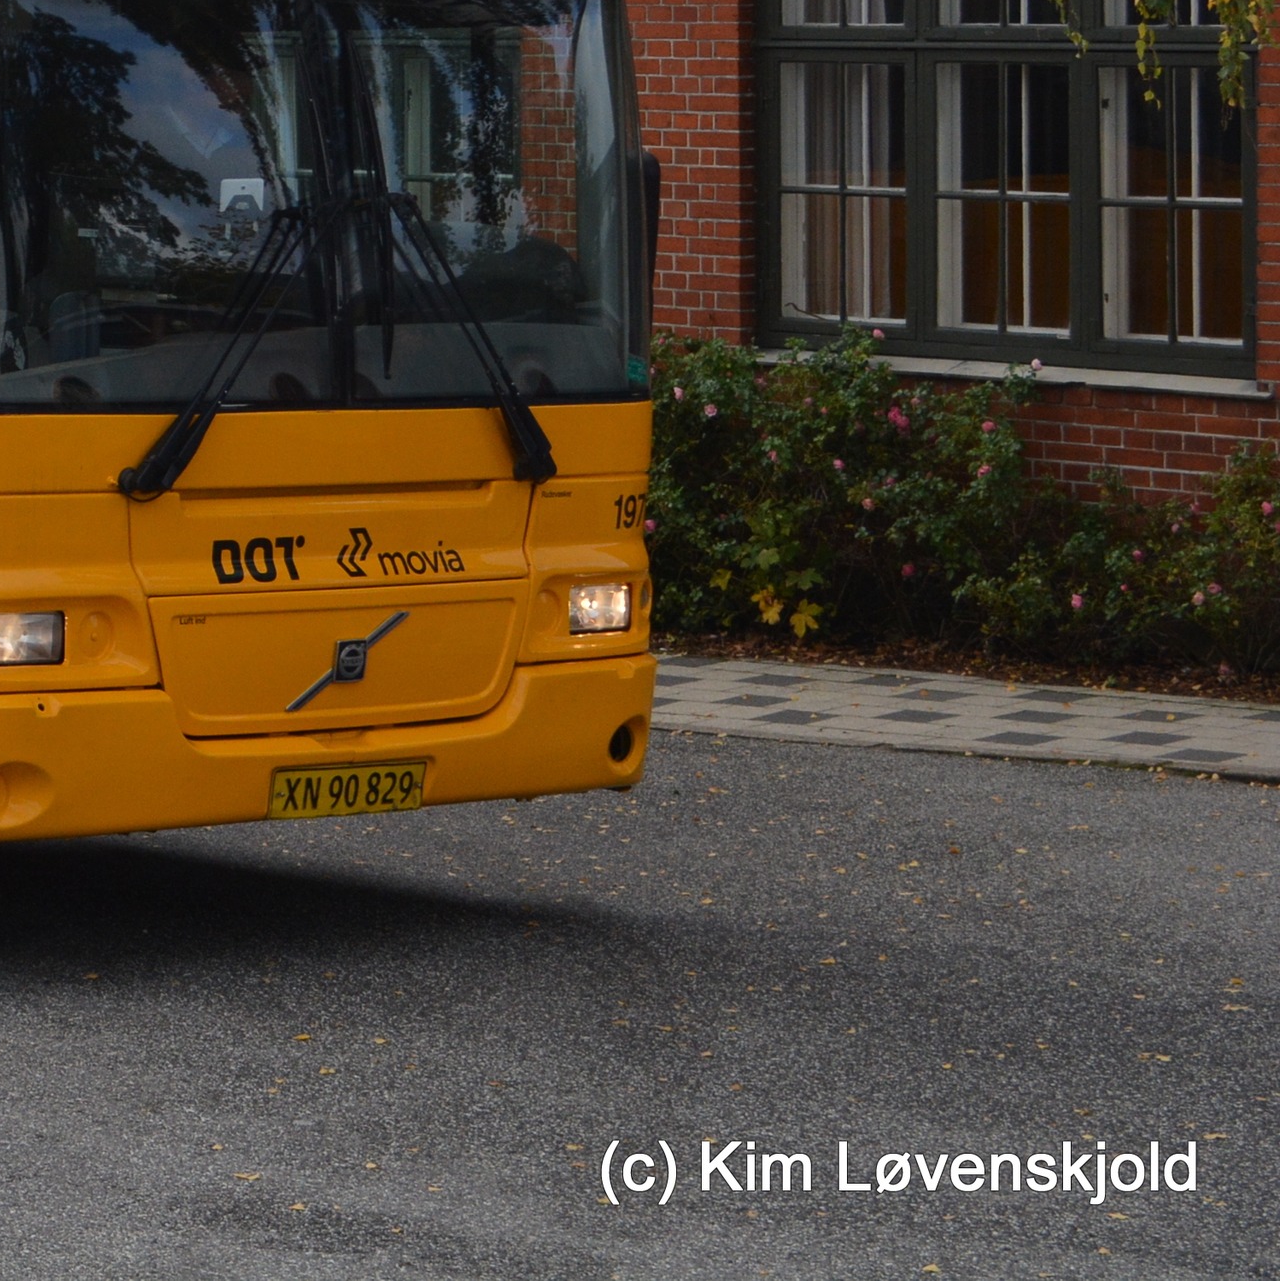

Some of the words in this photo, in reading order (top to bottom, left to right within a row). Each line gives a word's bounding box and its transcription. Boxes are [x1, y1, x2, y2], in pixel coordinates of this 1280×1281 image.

[211, 535, 306, 585] DOT
[377, 540, 466, 576] movia
[282, 776, 322, 811] XN
[329, 774, 360, 809] 90
[364, 770, 415, 806] 829
